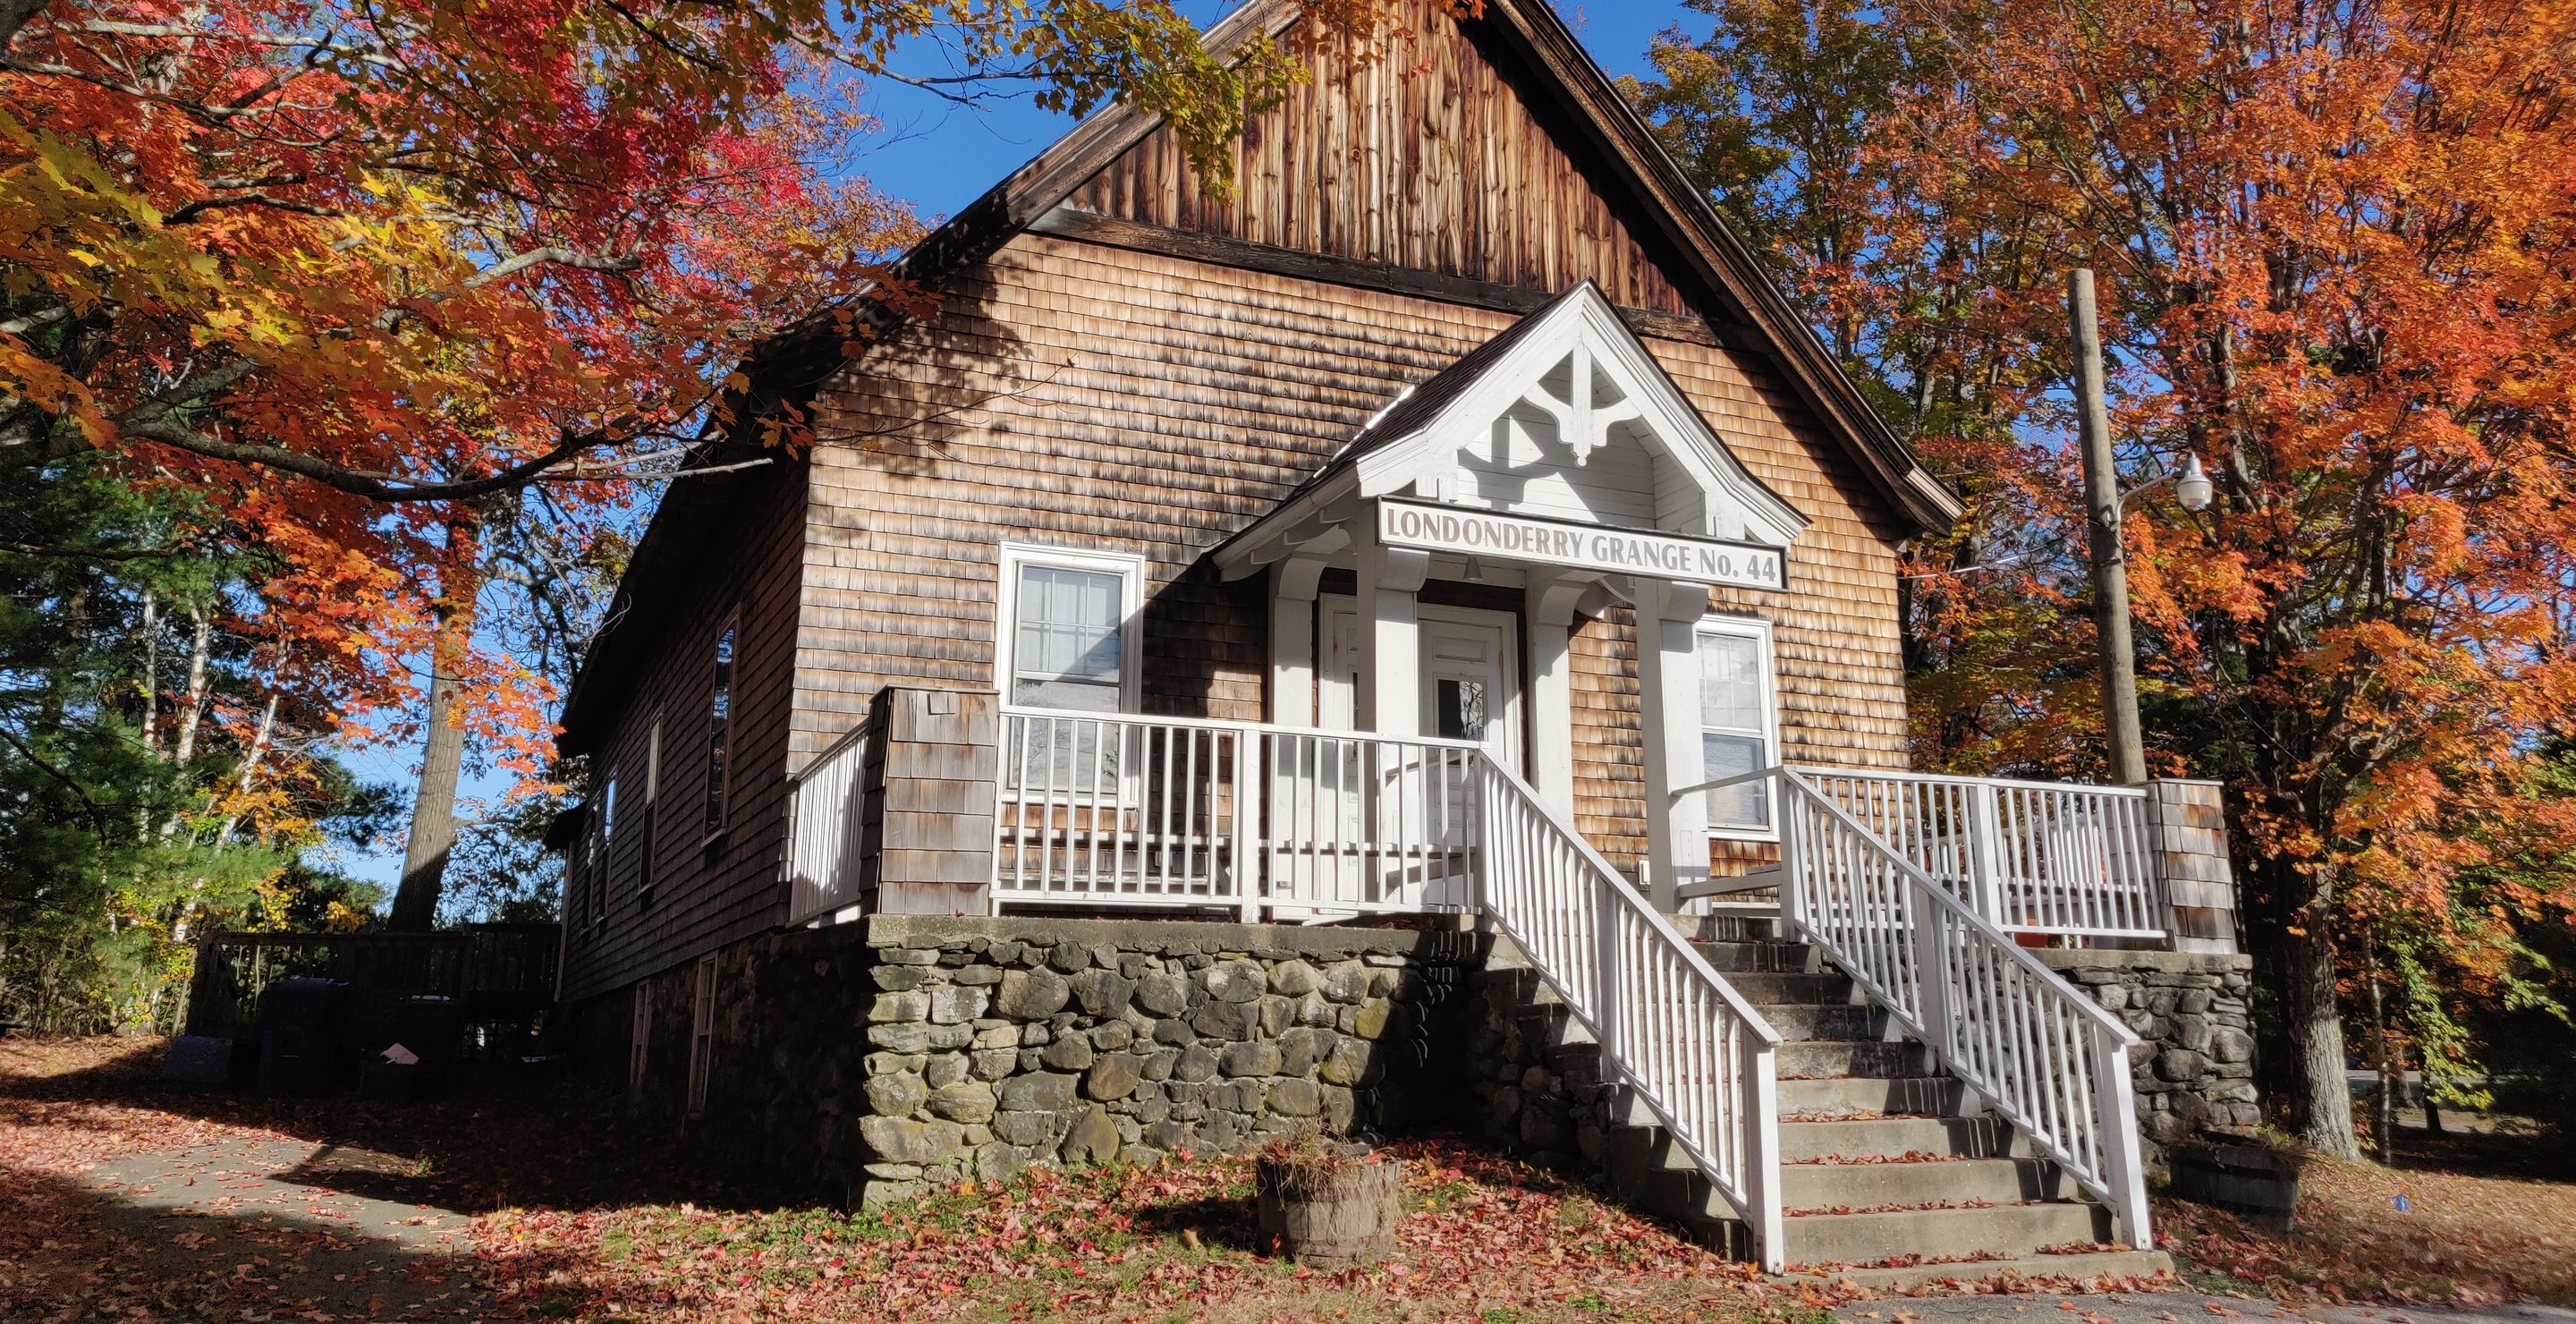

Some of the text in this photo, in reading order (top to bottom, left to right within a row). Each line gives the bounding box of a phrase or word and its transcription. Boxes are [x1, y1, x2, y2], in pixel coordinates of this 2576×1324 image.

[1387, 508, 1583, 558] LONDONDERRY
[1591, 535, 1691, 572] GRANGE
[1747, 555, 1776, 581] 44
